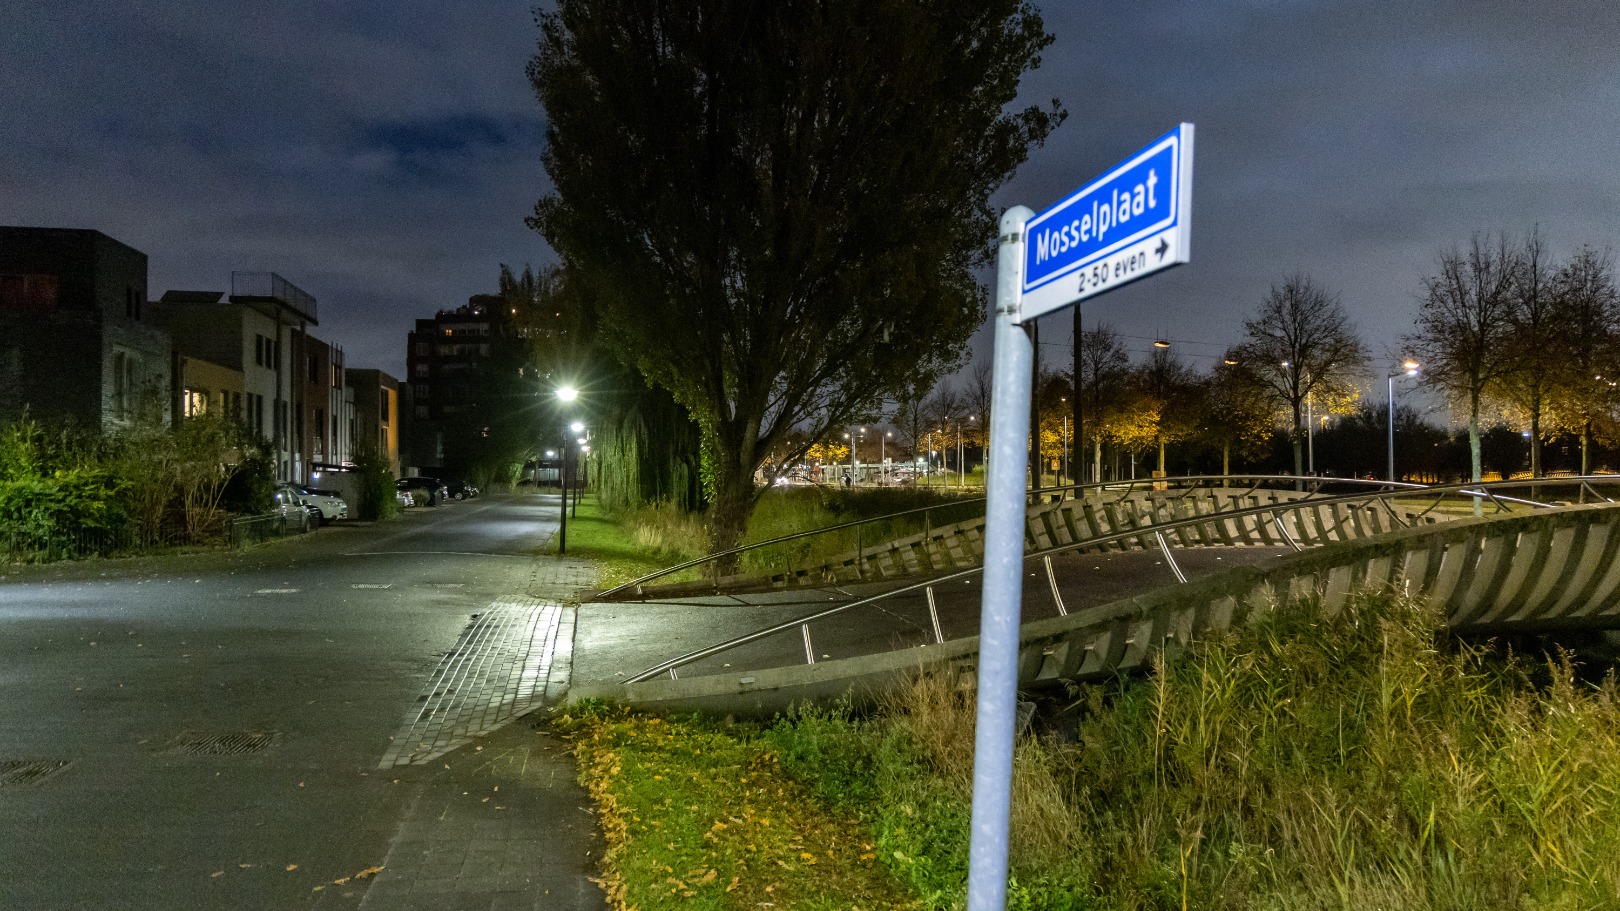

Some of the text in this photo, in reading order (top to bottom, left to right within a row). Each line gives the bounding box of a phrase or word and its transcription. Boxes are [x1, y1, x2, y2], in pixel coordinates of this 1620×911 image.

[1036, 168, 1157, 265] Mosselplaat
[1078, 250, 1146, 293] 2-50 even
